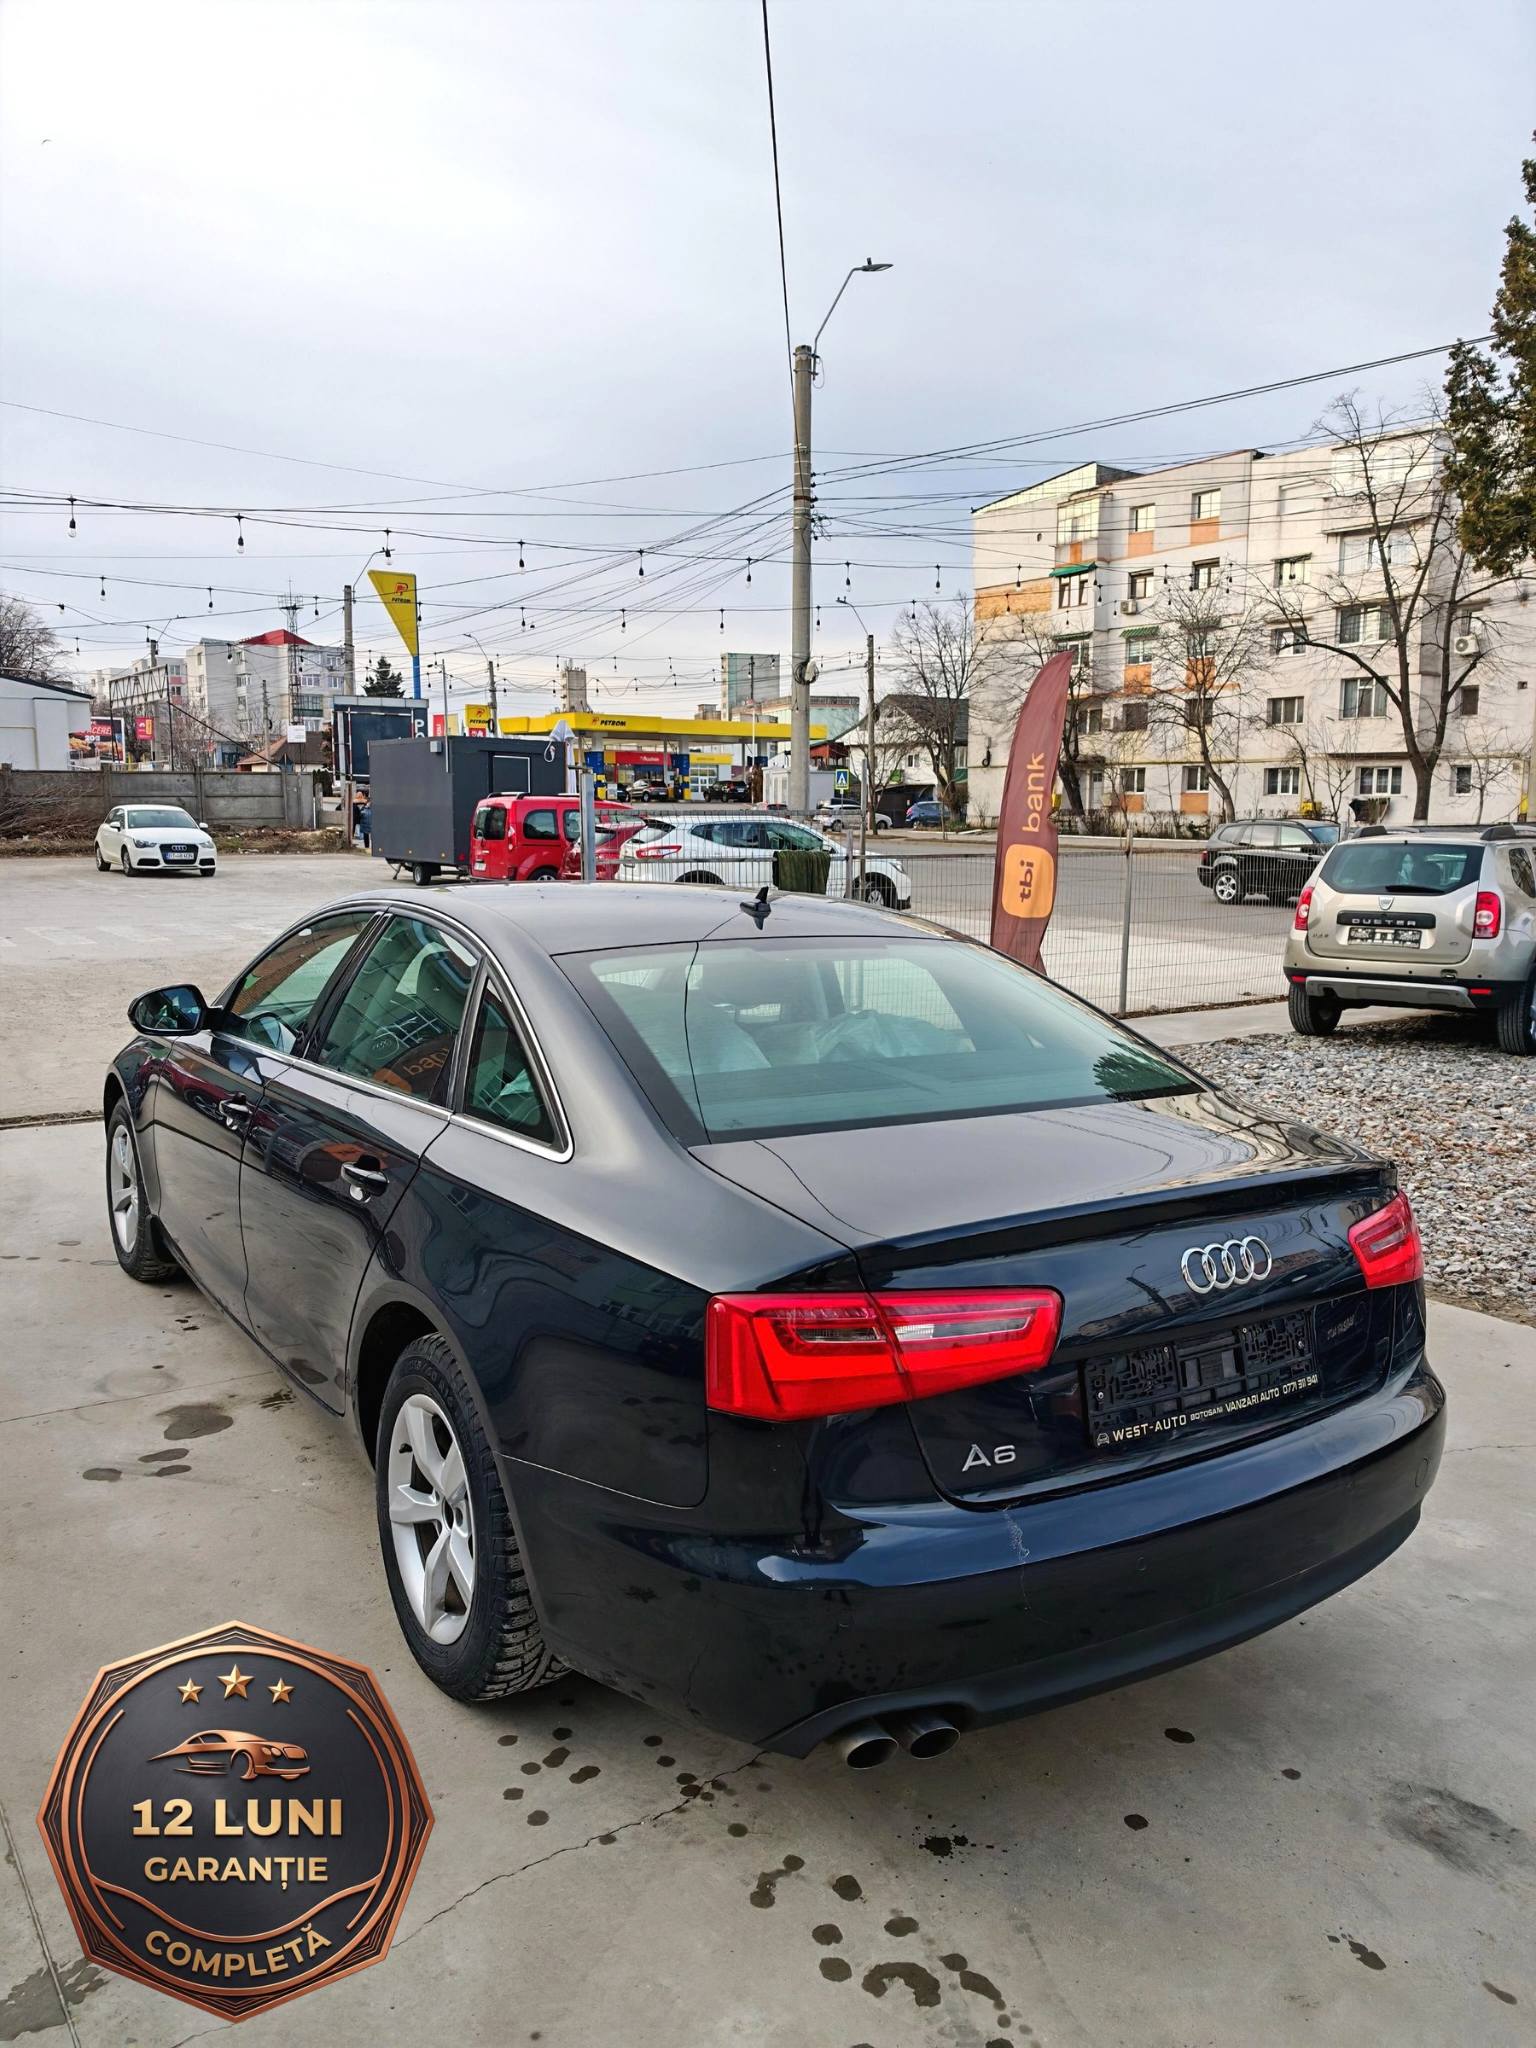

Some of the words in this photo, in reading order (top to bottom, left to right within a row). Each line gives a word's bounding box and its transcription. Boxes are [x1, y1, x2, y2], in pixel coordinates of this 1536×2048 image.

[600, 719, 626, 727] PETROM
[1022, 752, 1045, 833] bank
[1019, 859, 1035, 903] tbi
[1351, 918, 1416, 927] DUSTER
[1112, 1414, 1187, 1442] WEST-AUTO
[1225, 1394, 1259, 1412] VANZARI
[1260, 1387, 1280, 1403] AUTO
[1282, 1381, 1297, 1394] 0771
[961, 1444, 1016, 1472] A6
